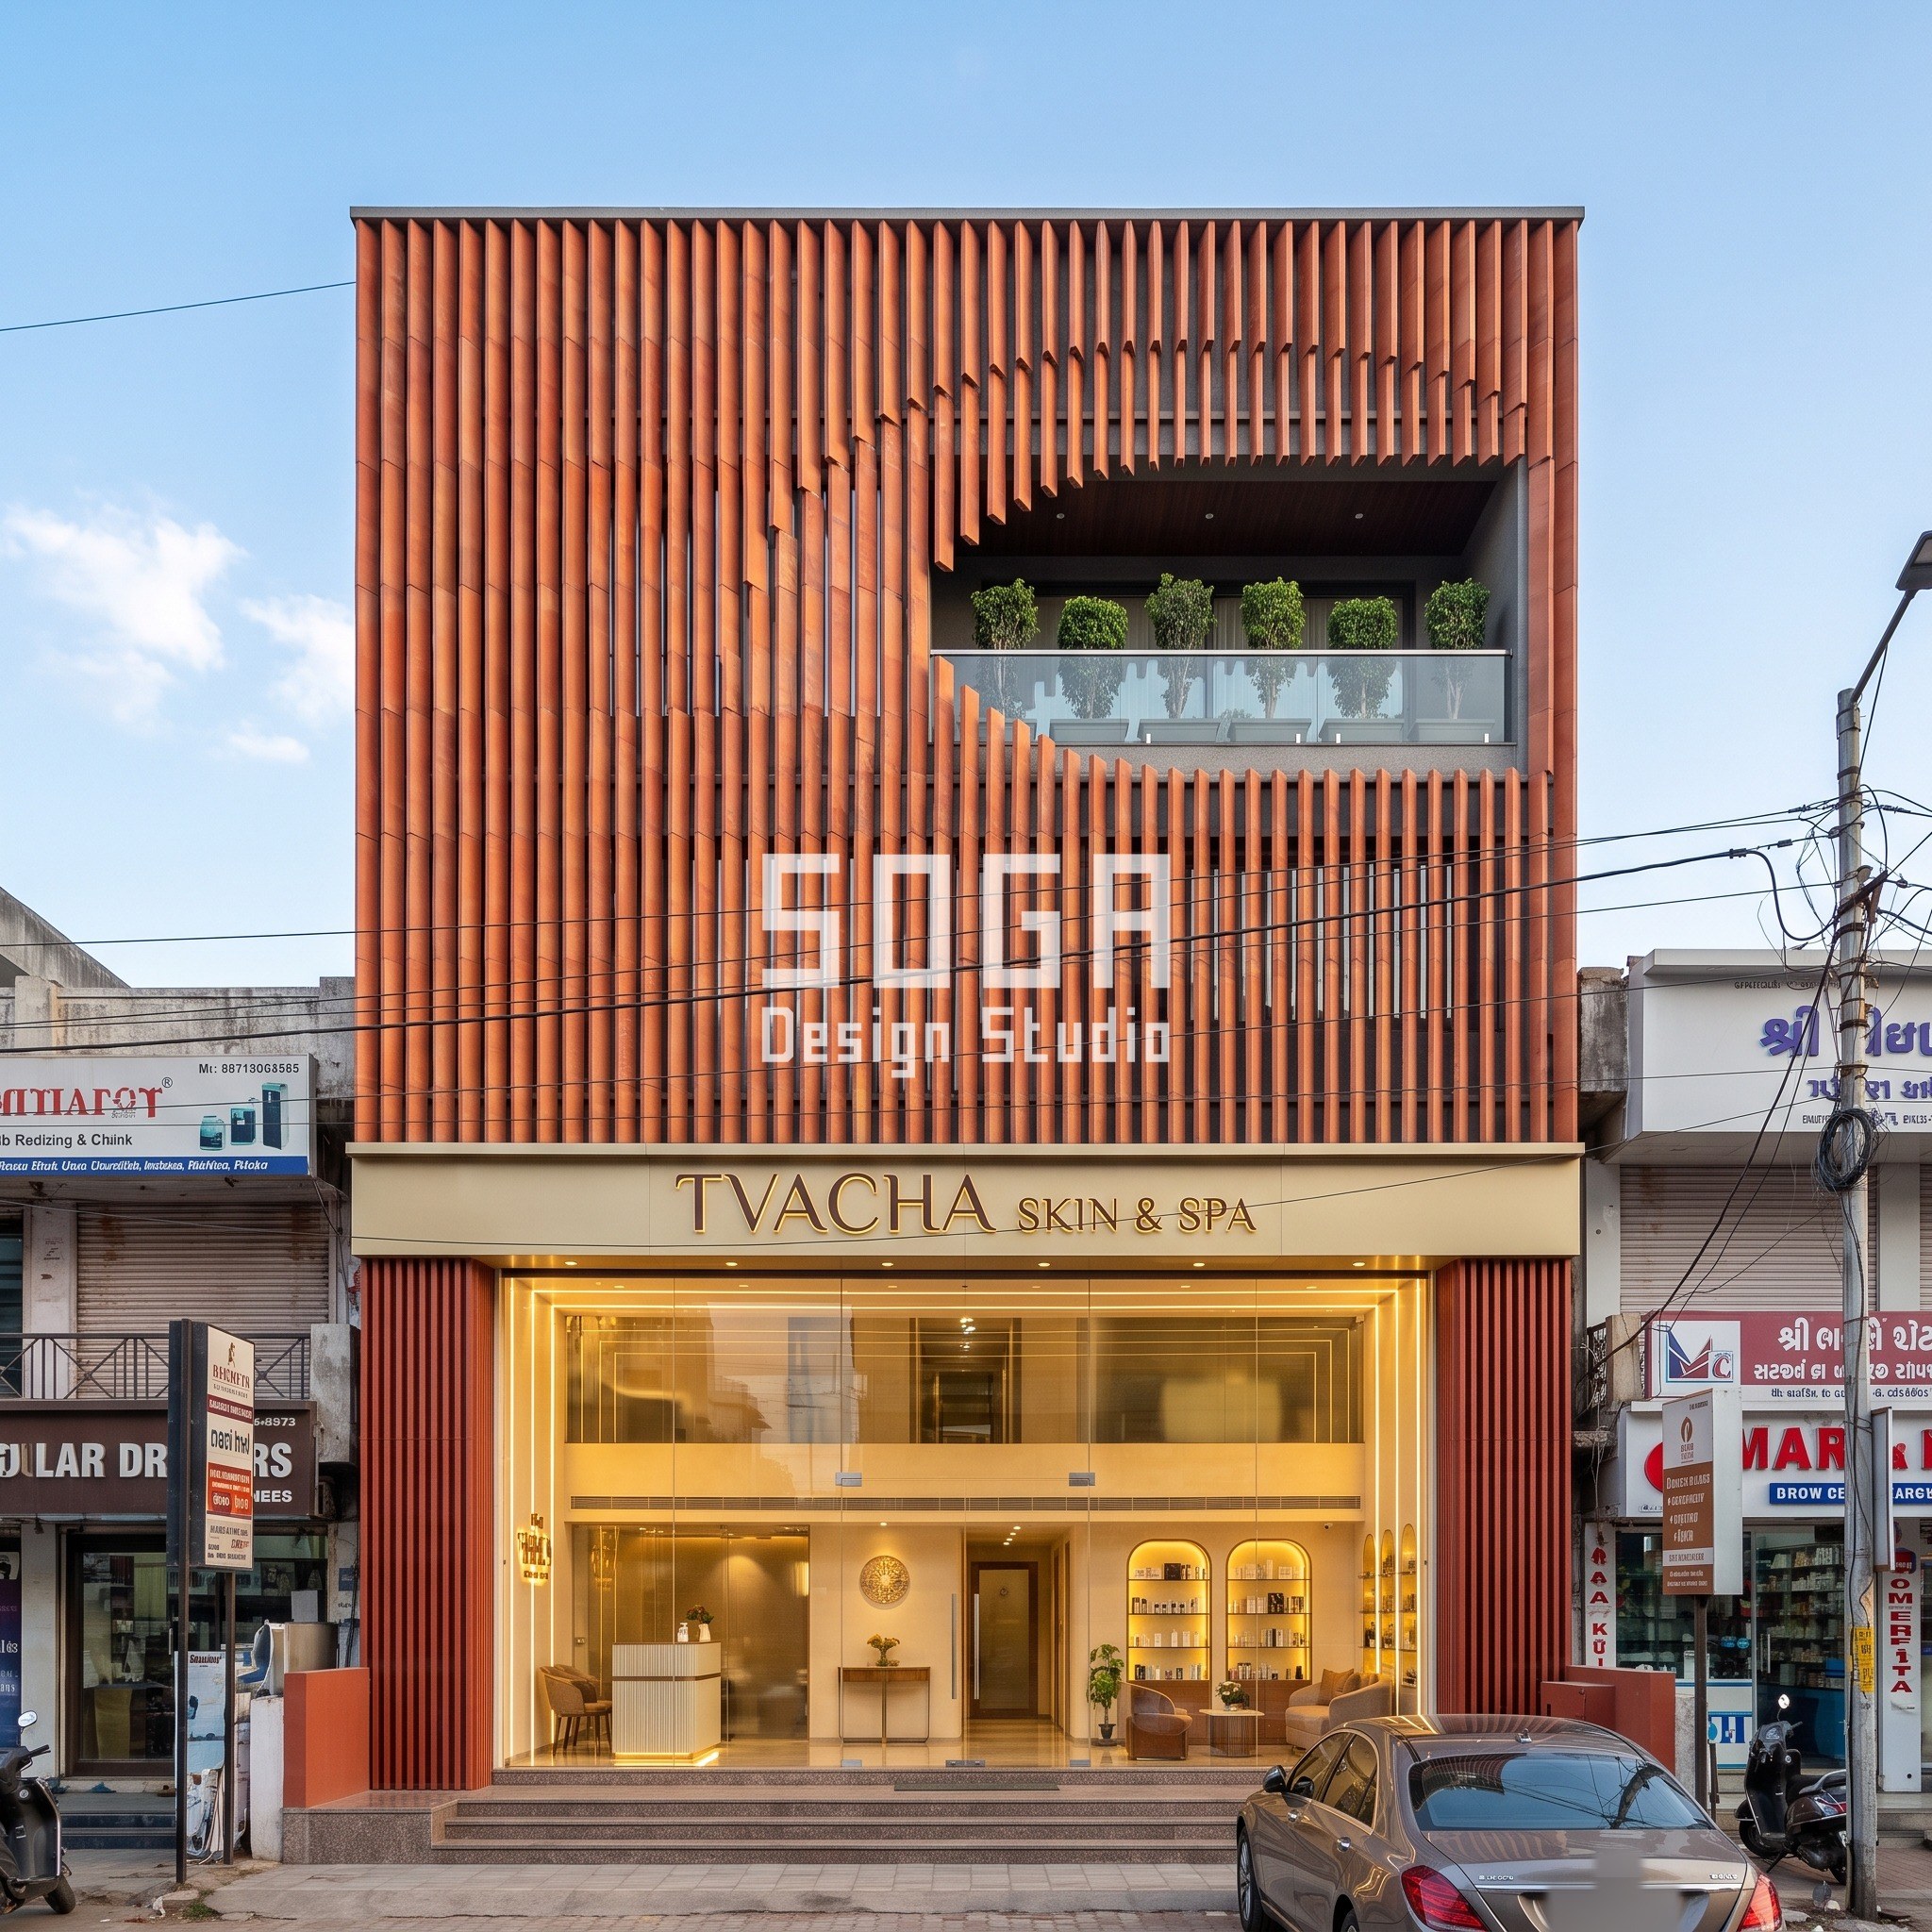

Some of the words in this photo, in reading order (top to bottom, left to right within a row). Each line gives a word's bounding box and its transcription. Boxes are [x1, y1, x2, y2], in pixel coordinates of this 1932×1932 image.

[15, 1134, 73, 1149] Redizing
[77, 1133, 87, 1146] &
[675, 1173, 996, 1235] TVACHA
[1018, 1197, 1119, 1233] SKIN
[1135, 1197, 1162, 1231] &
[1178, 1197, 1257, 1233] SPA
[1776, 1487, 1822, 1499] BROW
